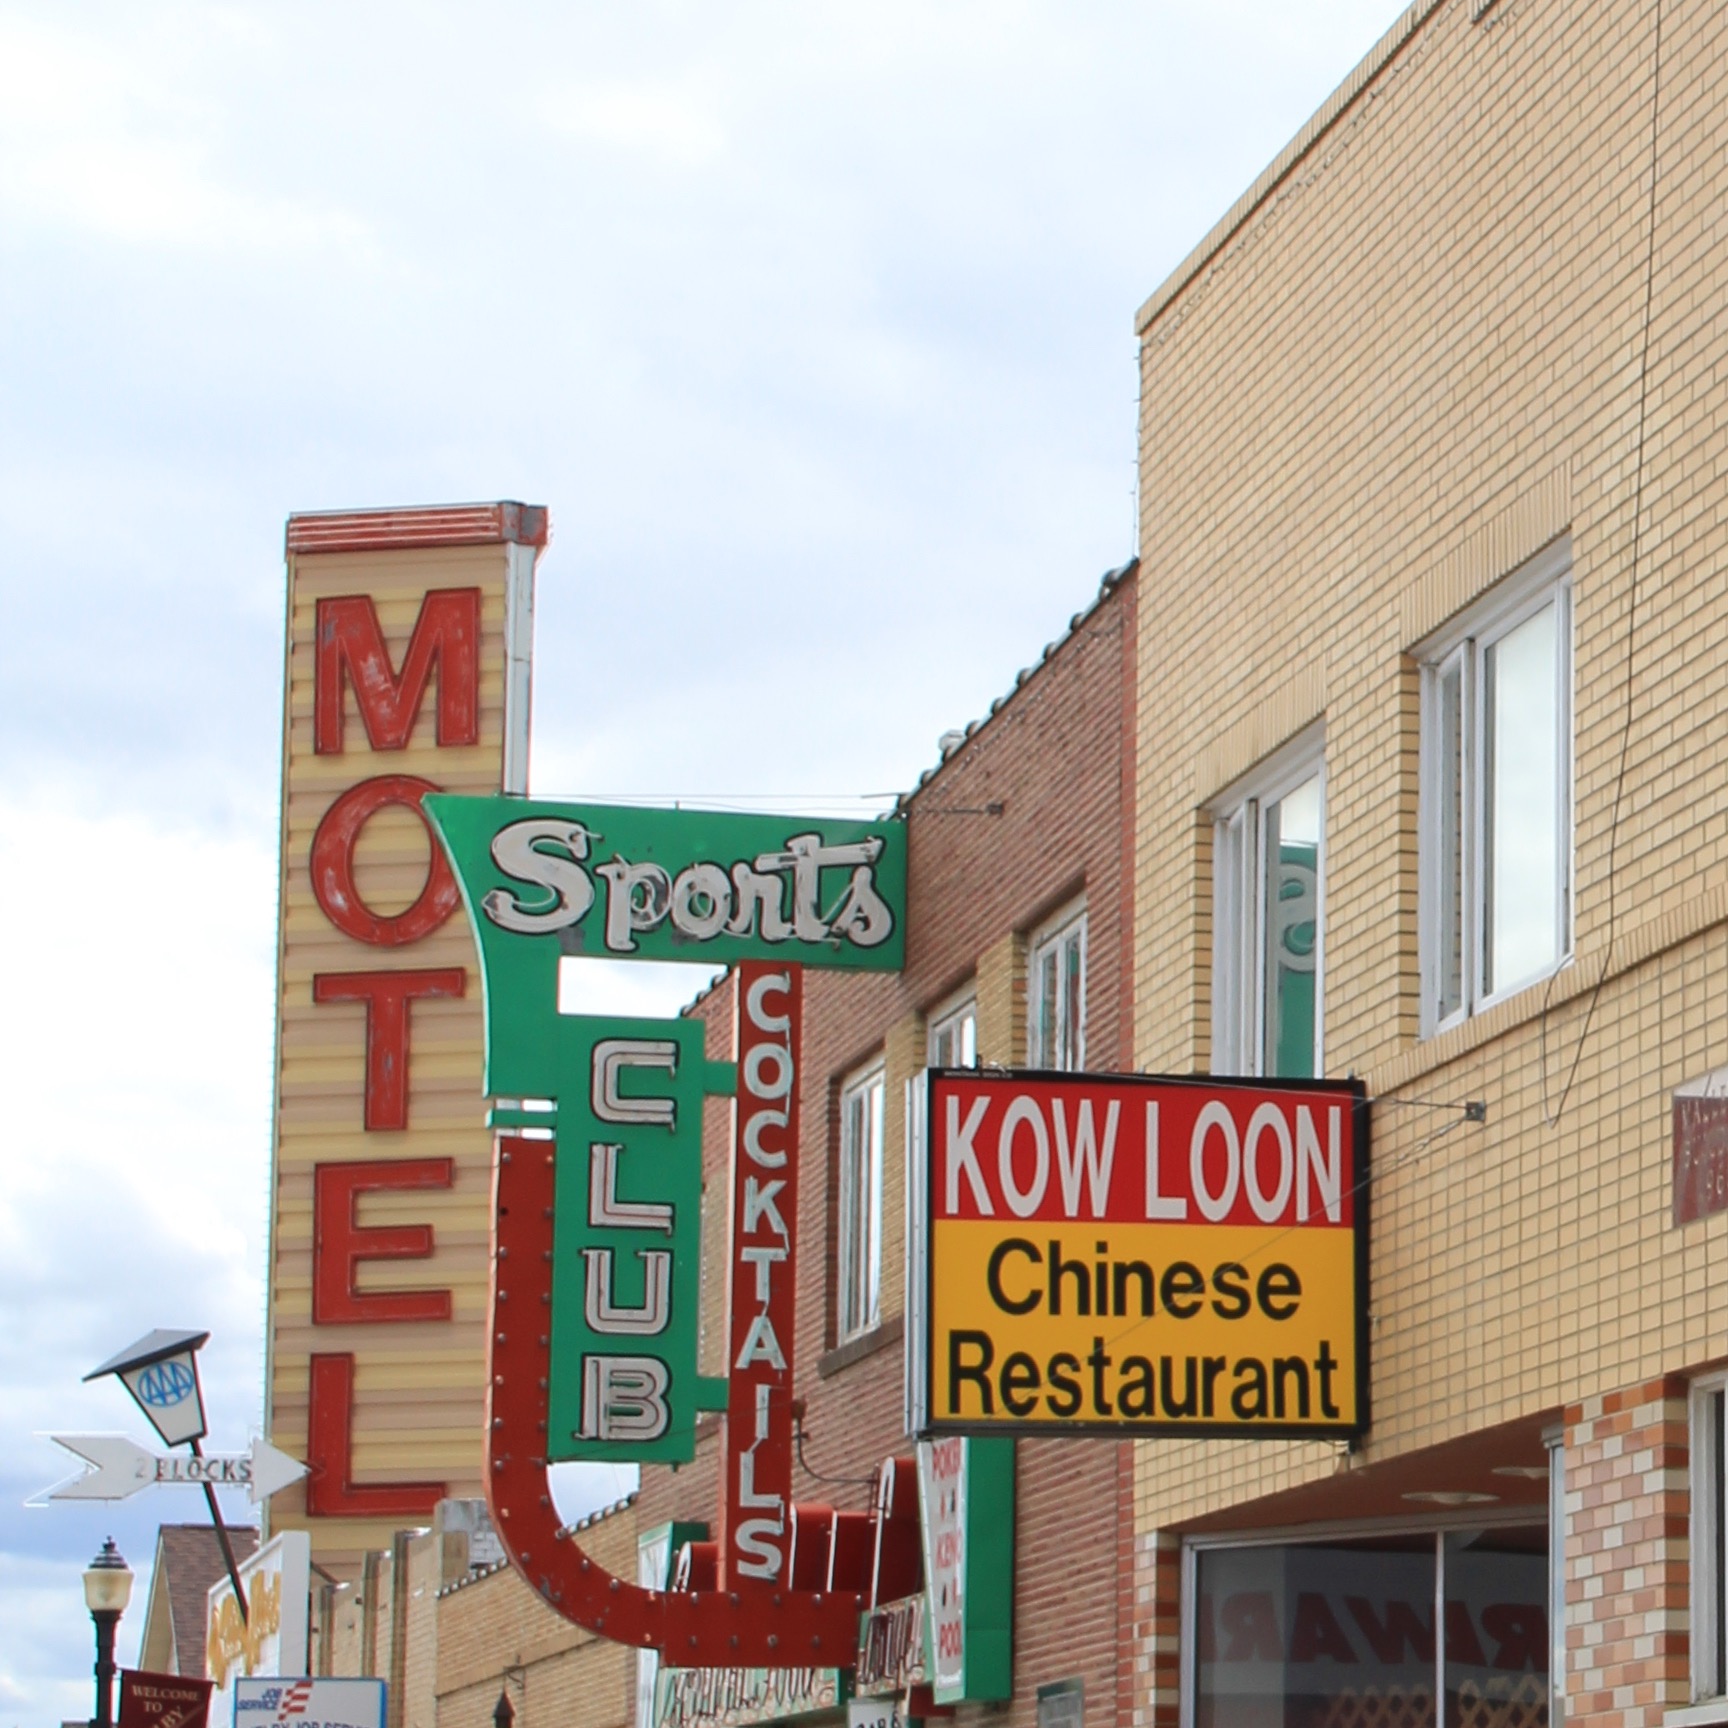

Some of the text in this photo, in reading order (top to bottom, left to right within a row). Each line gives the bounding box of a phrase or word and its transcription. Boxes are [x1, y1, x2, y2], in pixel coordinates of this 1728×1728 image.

[481, 815, 896, 952] Sports
[306, 587, 482, 1518] MOTEL
[945, 1094, 1342, 1223] KOW LOON
[581, 1036, 678, 1444] CLUB
[734, 973, 792, 1583] COCKTAILS
[986, 1237, 1303, 1321] Chinese
[947, 1328, 1340, 1420] Restaurant
[156, 1458, 252, 1481] BLOCKS
[131, 1684, 199, 1701] WELCOME
[144, 1700, 163, 1713] TO
